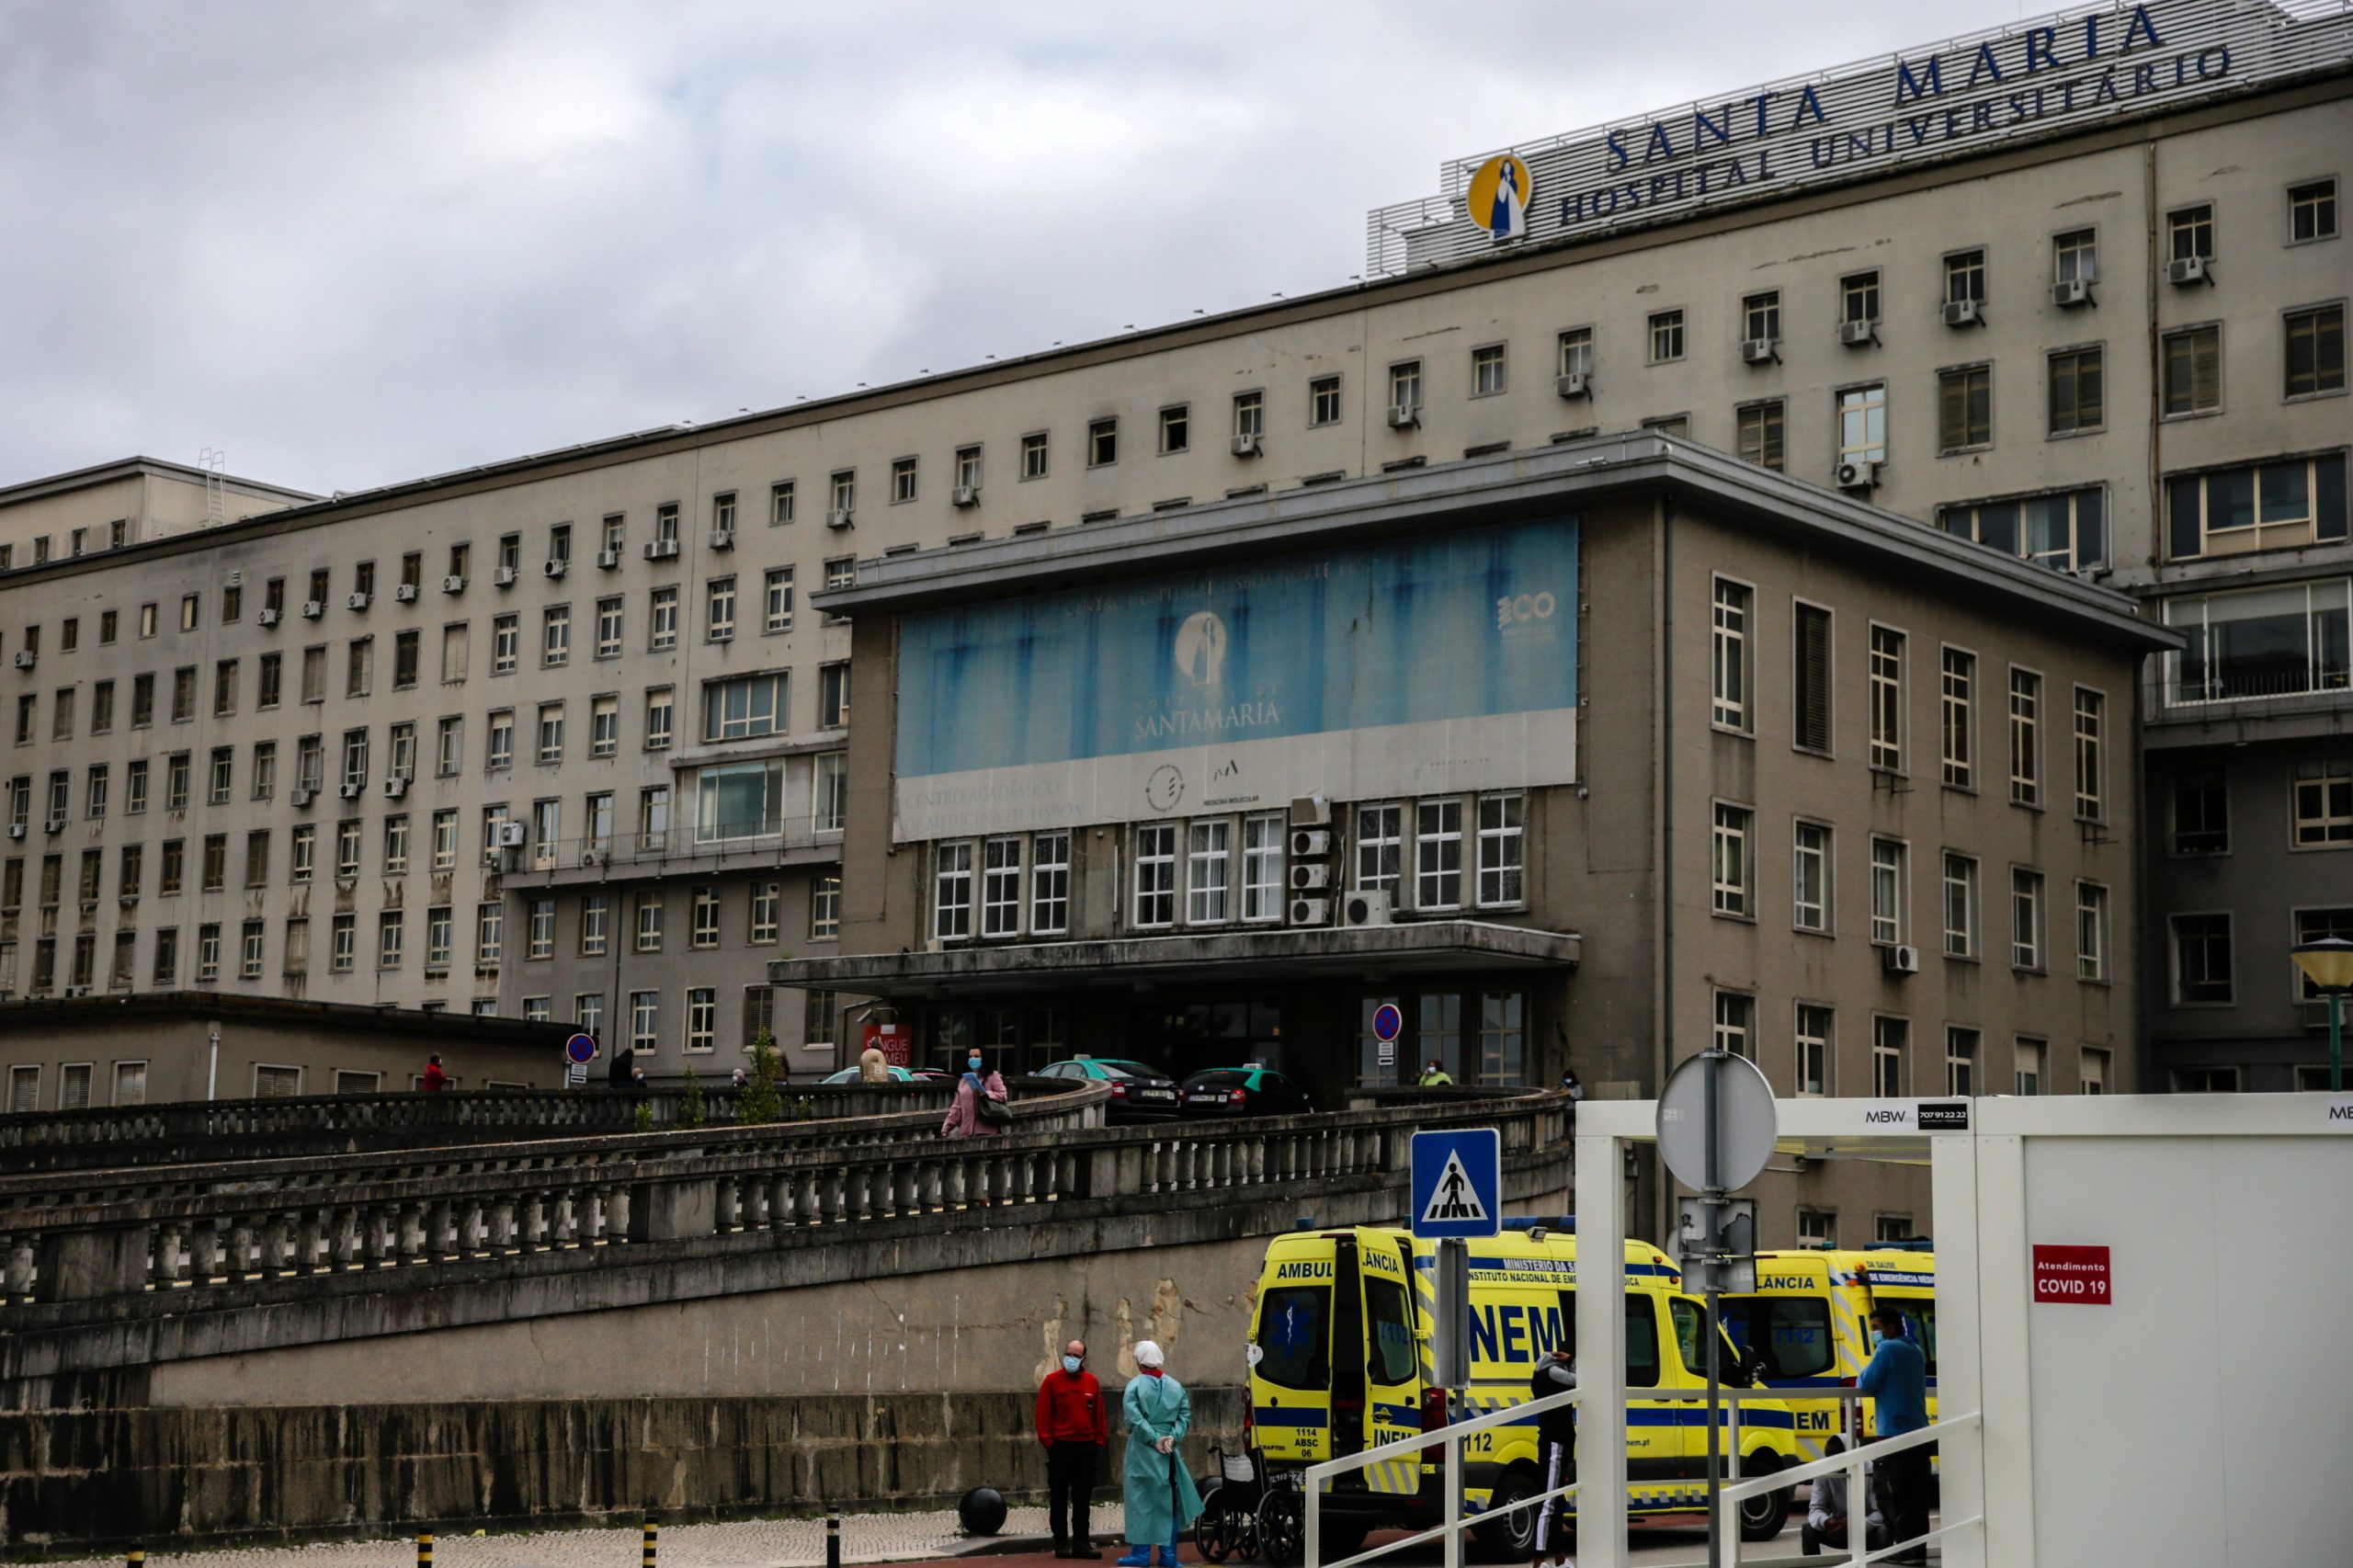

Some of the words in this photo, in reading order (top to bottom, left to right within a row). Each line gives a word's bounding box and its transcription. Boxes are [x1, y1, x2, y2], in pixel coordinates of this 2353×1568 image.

[1606, 83, 1830, 174] SANTA
[1894, 2, 2165, 108] MARIA
[1562, 150, 1775, 226] HOSPITAL
[1811, 44, 2232, 169] UNIVERSITÁRIO
[1866, 1110, 1905, 1123] MBW
[2329, 1106, 2353, 1120] MB
[2038, 1261, 2106, 1272] Atendimento
[1469, 1271, 1508, 1282] NSTITUTO
[1509, 1273, 1550, 1283] NACIONAL
[1551, 1274, 1563, 1284] DE
[2038, 1278, 2085, 1294] COVID
[2089, 1279, 2107, 1294] 19
[1469, 1305, 1563, 1363] NEM
[1295, 1428, 1317, 1437] 1114
[1294, 1438, 1318, 1448] ABSC
[1464, 1432, 1493, 1452] 112
[1625, 1437, 1651, 1448] nem.pt
[1302, 1449, 1313, 1458] 06
